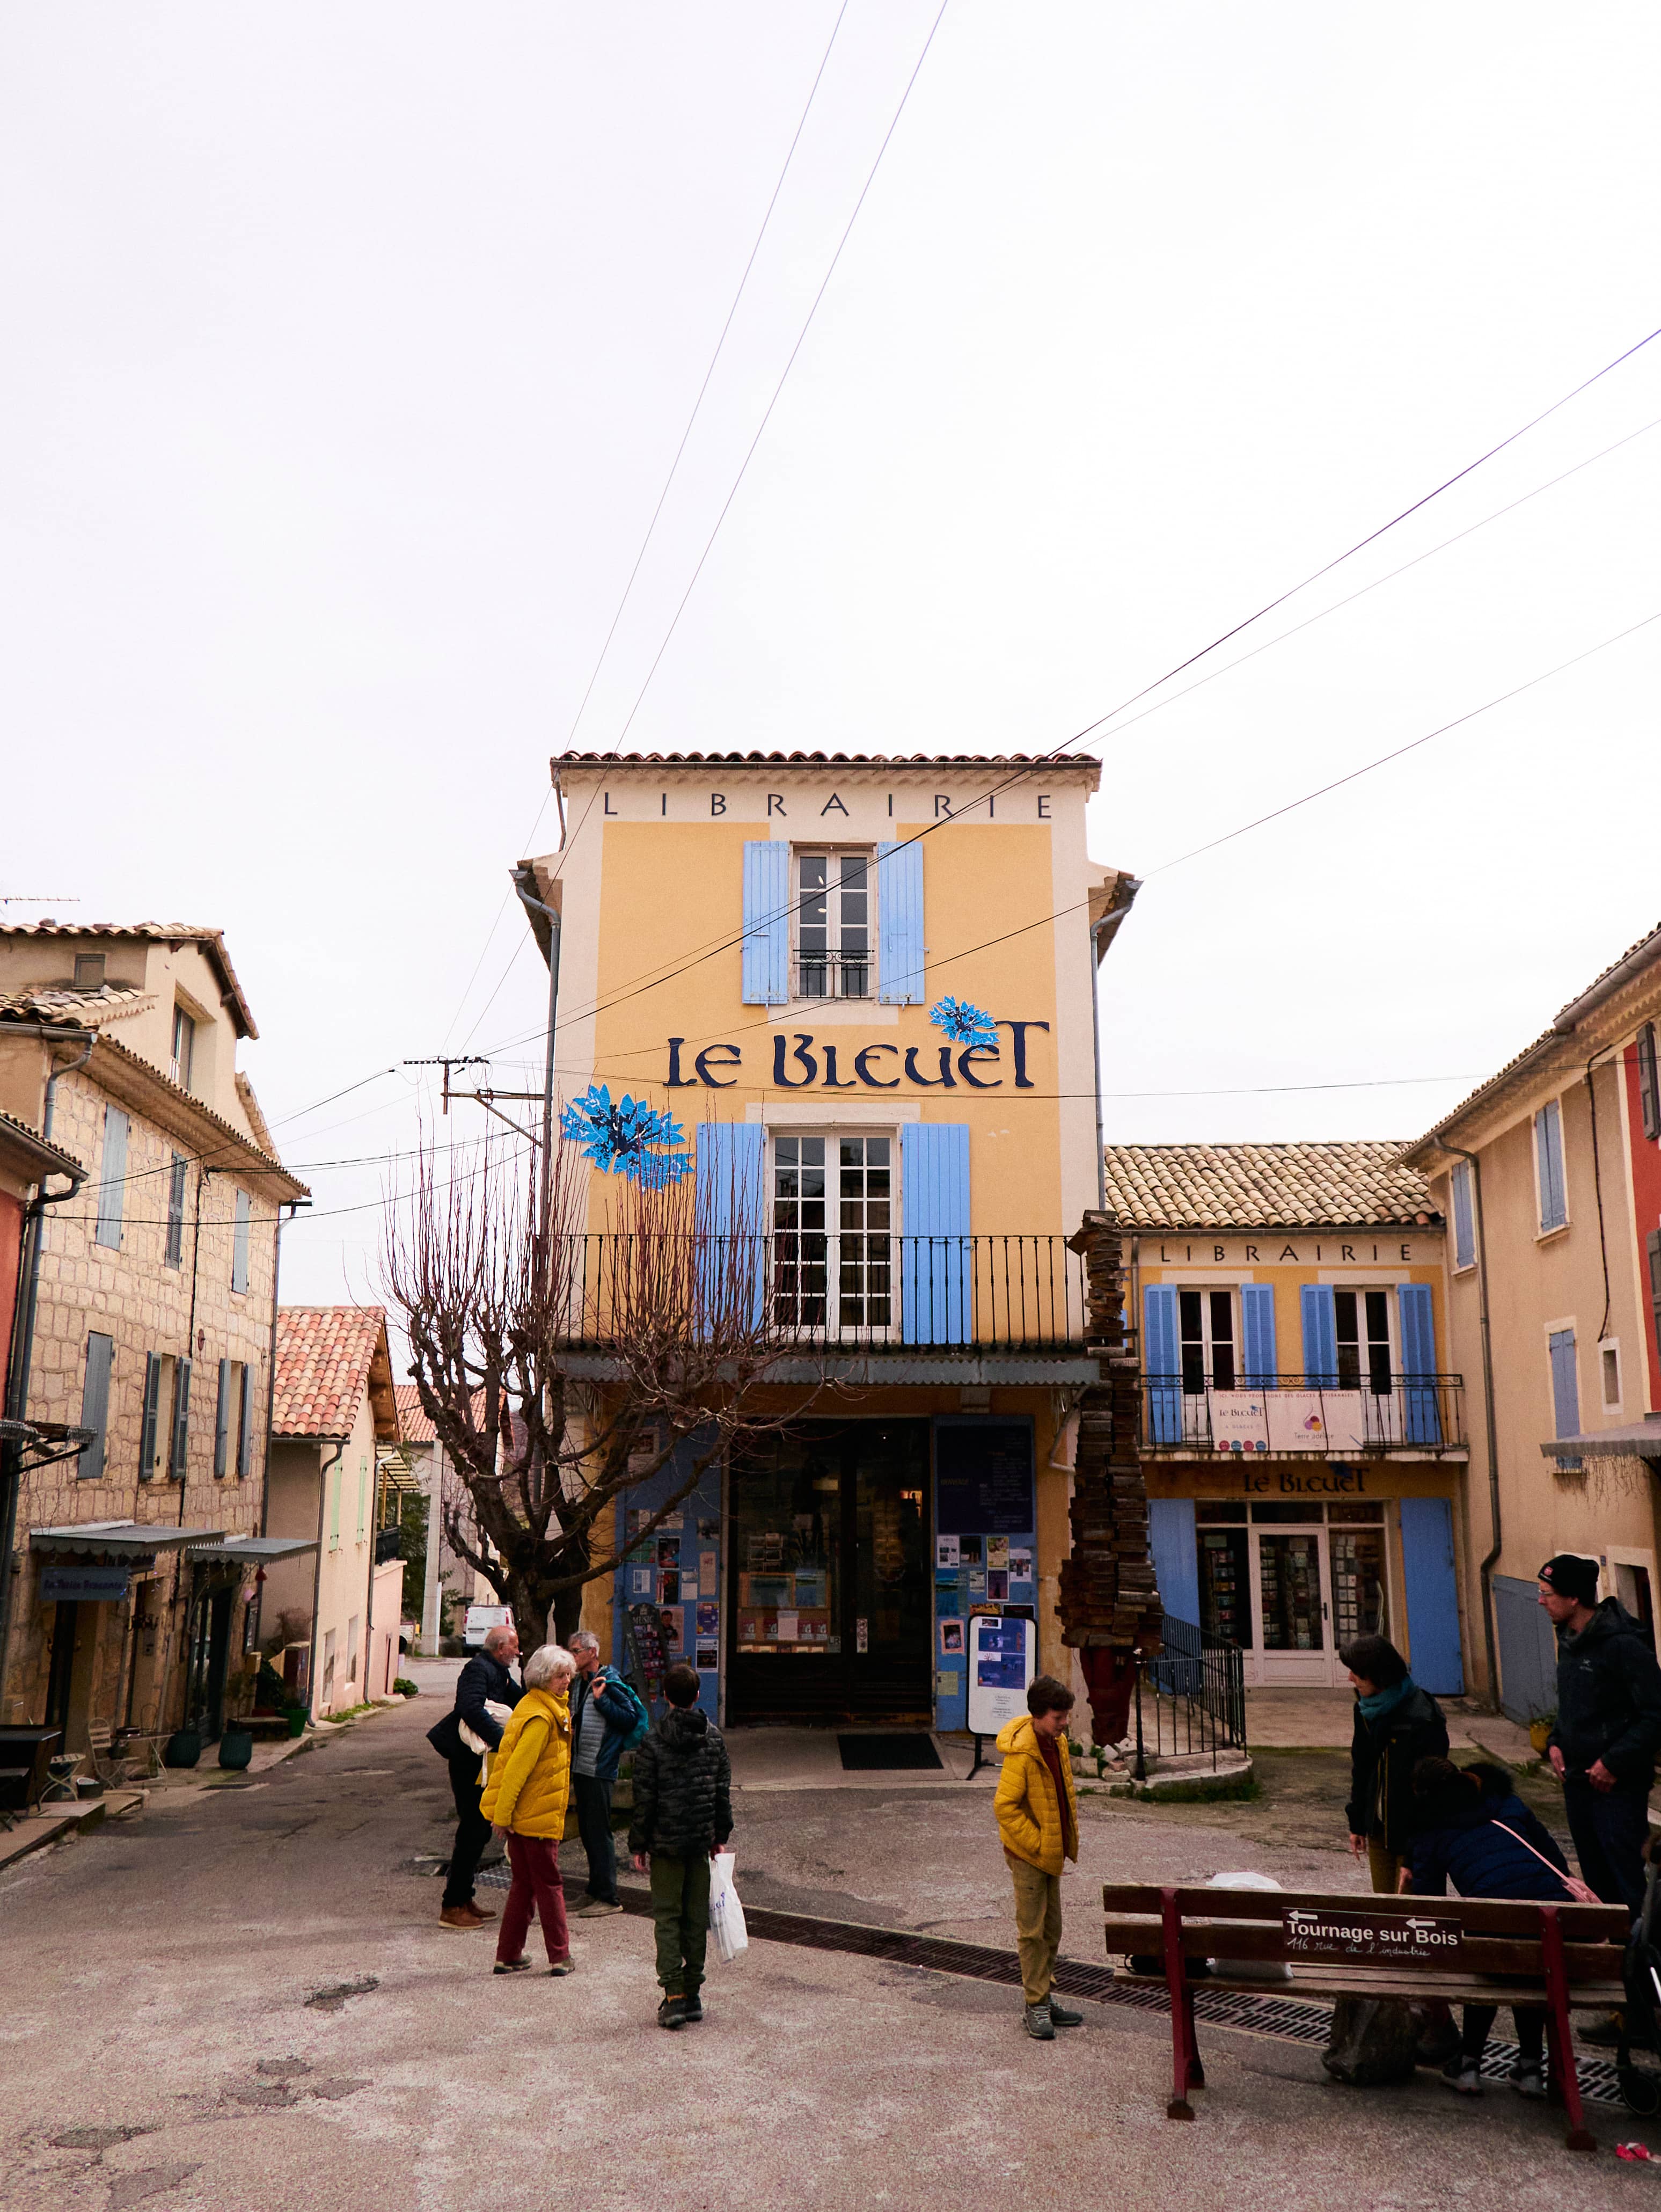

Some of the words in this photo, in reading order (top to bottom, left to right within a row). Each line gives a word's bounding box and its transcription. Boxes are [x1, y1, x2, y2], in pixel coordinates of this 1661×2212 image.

[604, 792, 1051, 818] LIBRAIRIE
[1161, 1244, 1411, 1262] LIBRAIRIE
[1286, 1921, 1373, 1942] Tournage
[1380, 1930, 1409, 1942] sur
[1416, 1929, 1458, 1945] Bois
[1287, 1937, 1308, 1950] 116
[1315, 1943, 1339, 1951] rue
[1345, 1943, 1364, 1952] de
